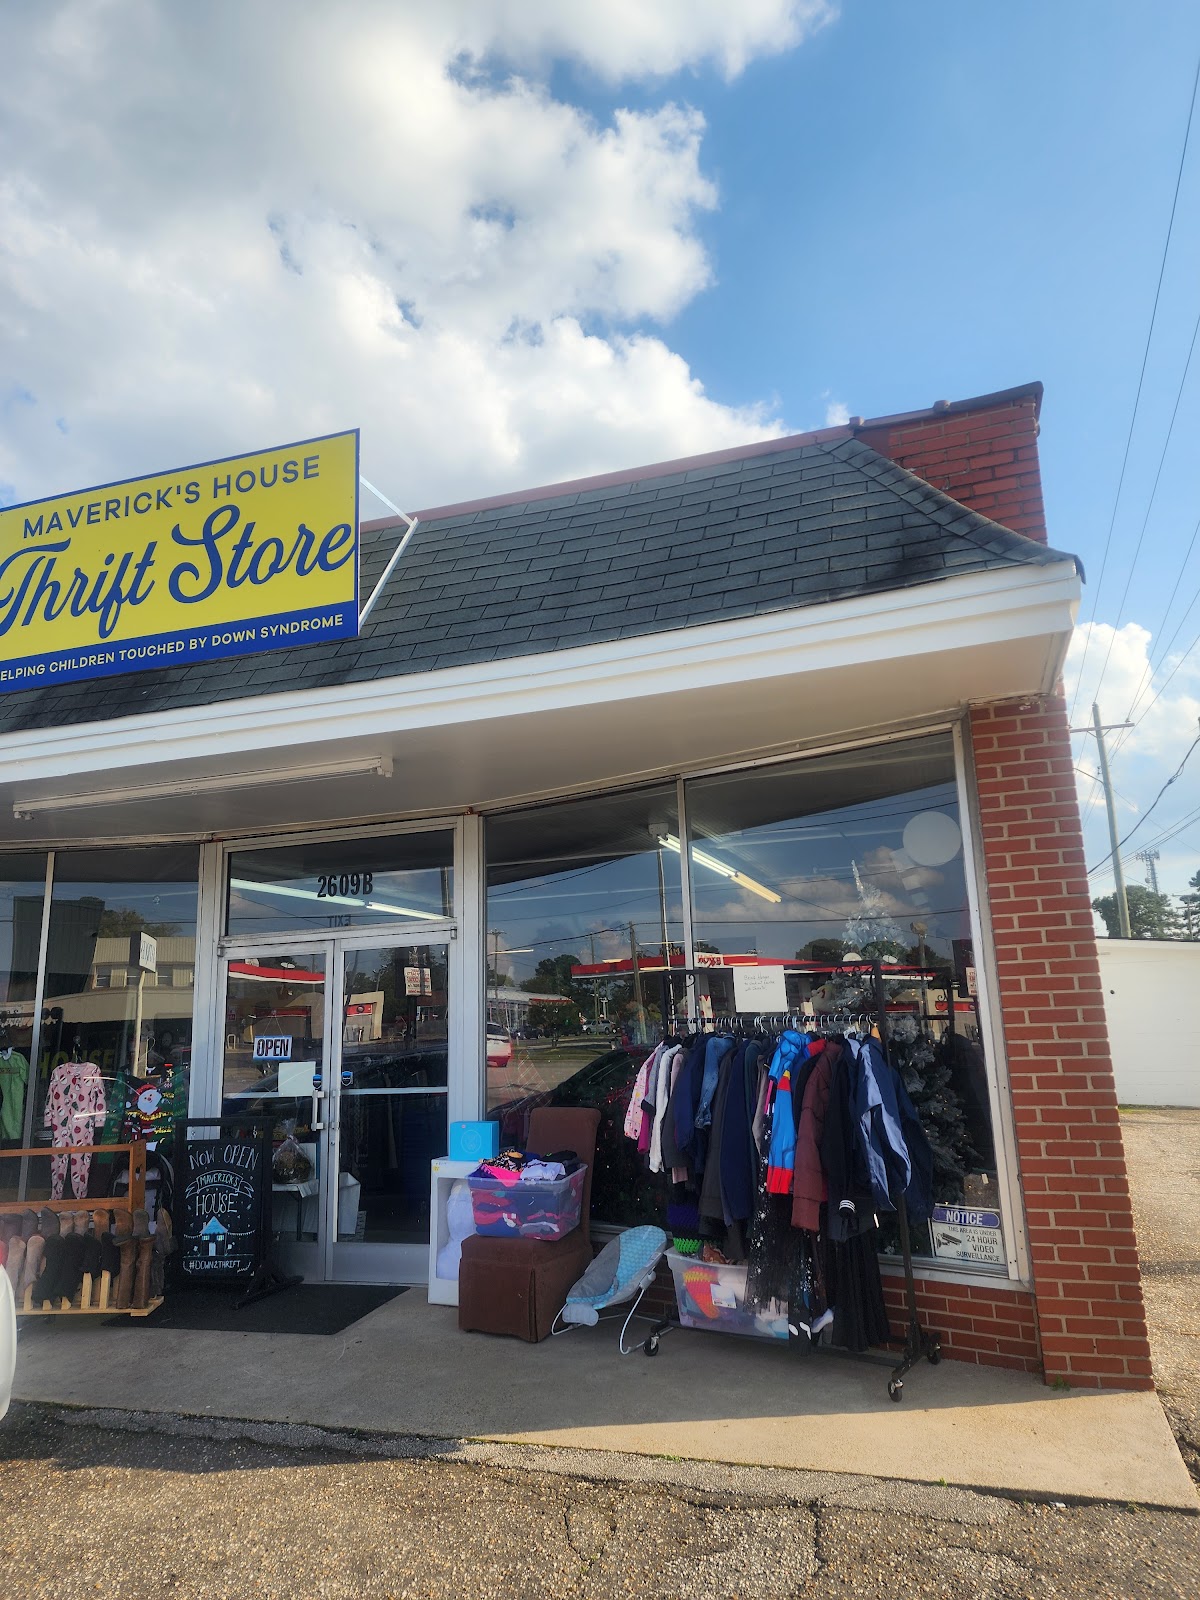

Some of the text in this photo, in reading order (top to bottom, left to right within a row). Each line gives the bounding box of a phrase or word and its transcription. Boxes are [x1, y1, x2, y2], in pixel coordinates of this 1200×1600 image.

[24, 455, 320, 538] MAVERICK'S HOUSE
[0, 504, 355, 639] Thrift Store
[0, 614, 343, 681] ELPING CHILDREN TOUCHED BY DOWN SYNDROME
[317, 872, 373, 898] 2609B
[256, 1038, 290, 1057] OPEN
[189, 1144, 259, 1170] NOW OPEN
[195, 1193, 239, 1216] HOUSE
[946, 1210, 983, 1225] NOTICE
[966, 1234, 998, 1246] 24 HOUR
[972, 1244, 995, 1254] VIDEO
[189, 1260, 240, 1270] #DOWN2THRIFT
[956, 1251, 1000, 1262] SURVEILLANCE
